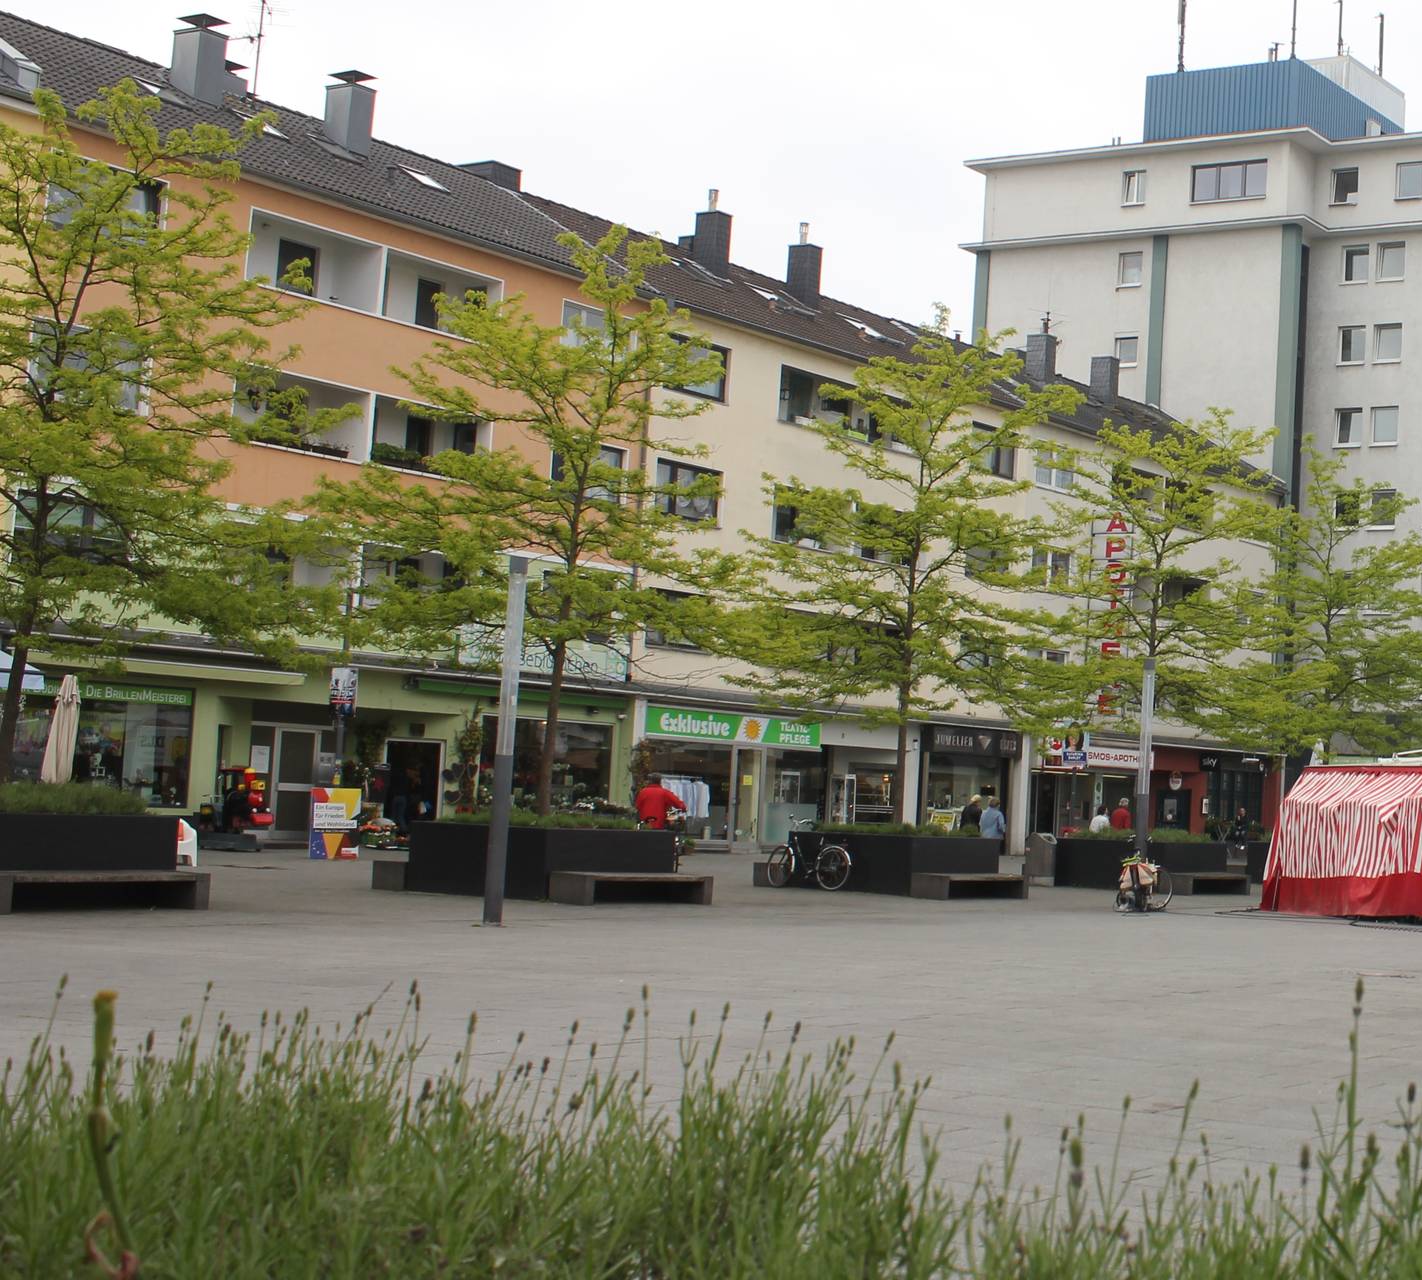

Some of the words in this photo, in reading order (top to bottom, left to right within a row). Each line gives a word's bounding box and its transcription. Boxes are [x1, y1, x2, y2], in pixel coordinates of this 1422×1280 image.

[660, 712, 730, 737] Exklusive
[779, 733, 811, 745] PFLEGE
[936, 734, 973, 748] JUWELIER
[1087, 751, 1139, 763] SMOS-APOTH
[1202, 757, 1217, 768] sky
